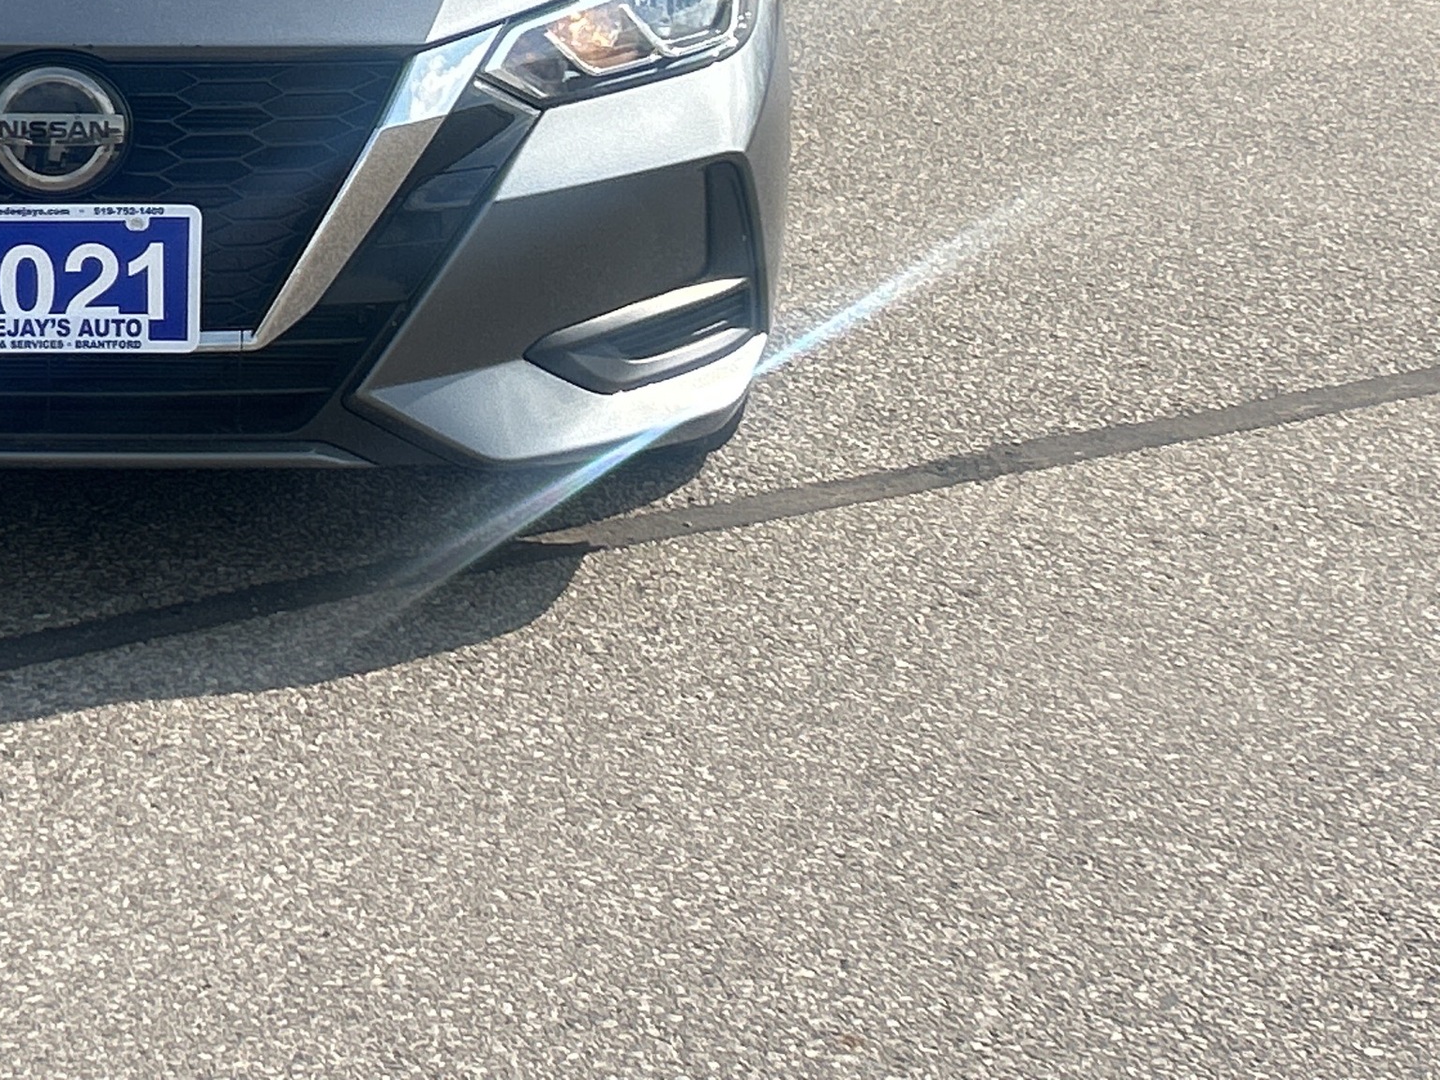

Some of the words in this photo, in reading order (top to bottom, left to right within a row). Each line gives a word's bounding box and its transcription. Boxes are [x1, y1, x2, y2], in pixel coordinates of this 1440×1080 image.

[78, 318, 142, 337] AUTO
[10, 339, 64, 350] SERVICES
[75, 339, 142, 350] BRANTFORD
